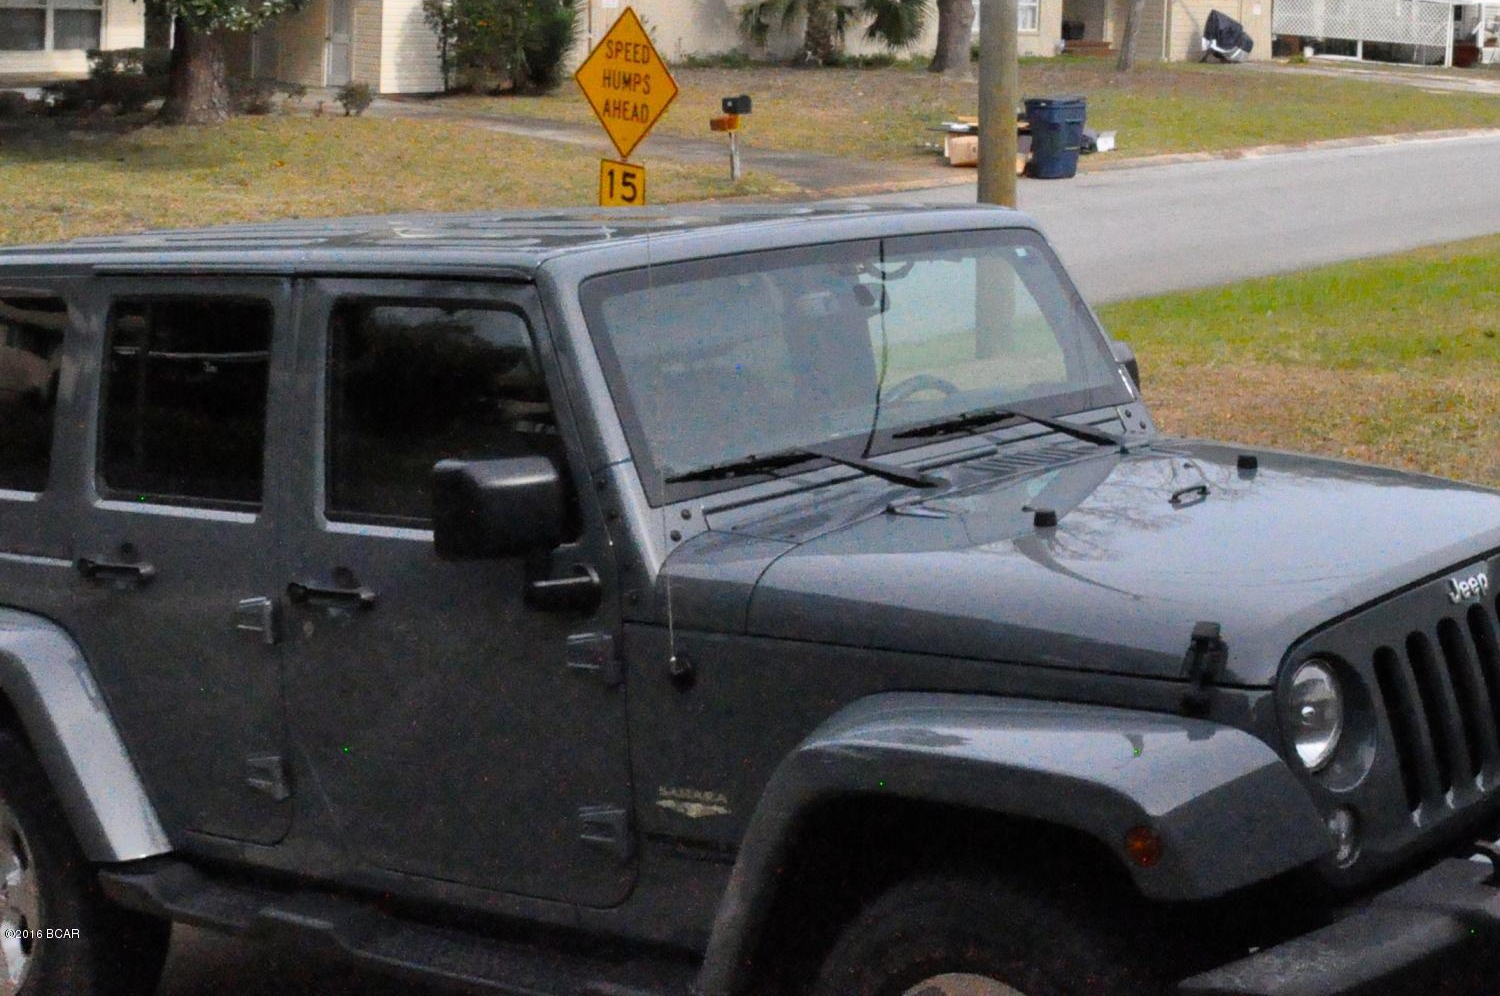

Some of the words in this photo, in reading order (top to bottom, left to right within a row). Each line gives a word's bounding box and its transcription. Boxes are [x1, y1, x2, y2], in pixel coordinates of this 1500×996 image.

[606, 40, 650, 64] SPEED
[603, 69, 650, 95] HUMPS
[603, 99, 649, 124] AHEAD
[608, 168, 637, 202] 15
[1449, 572, 1488, 604] Jeep
